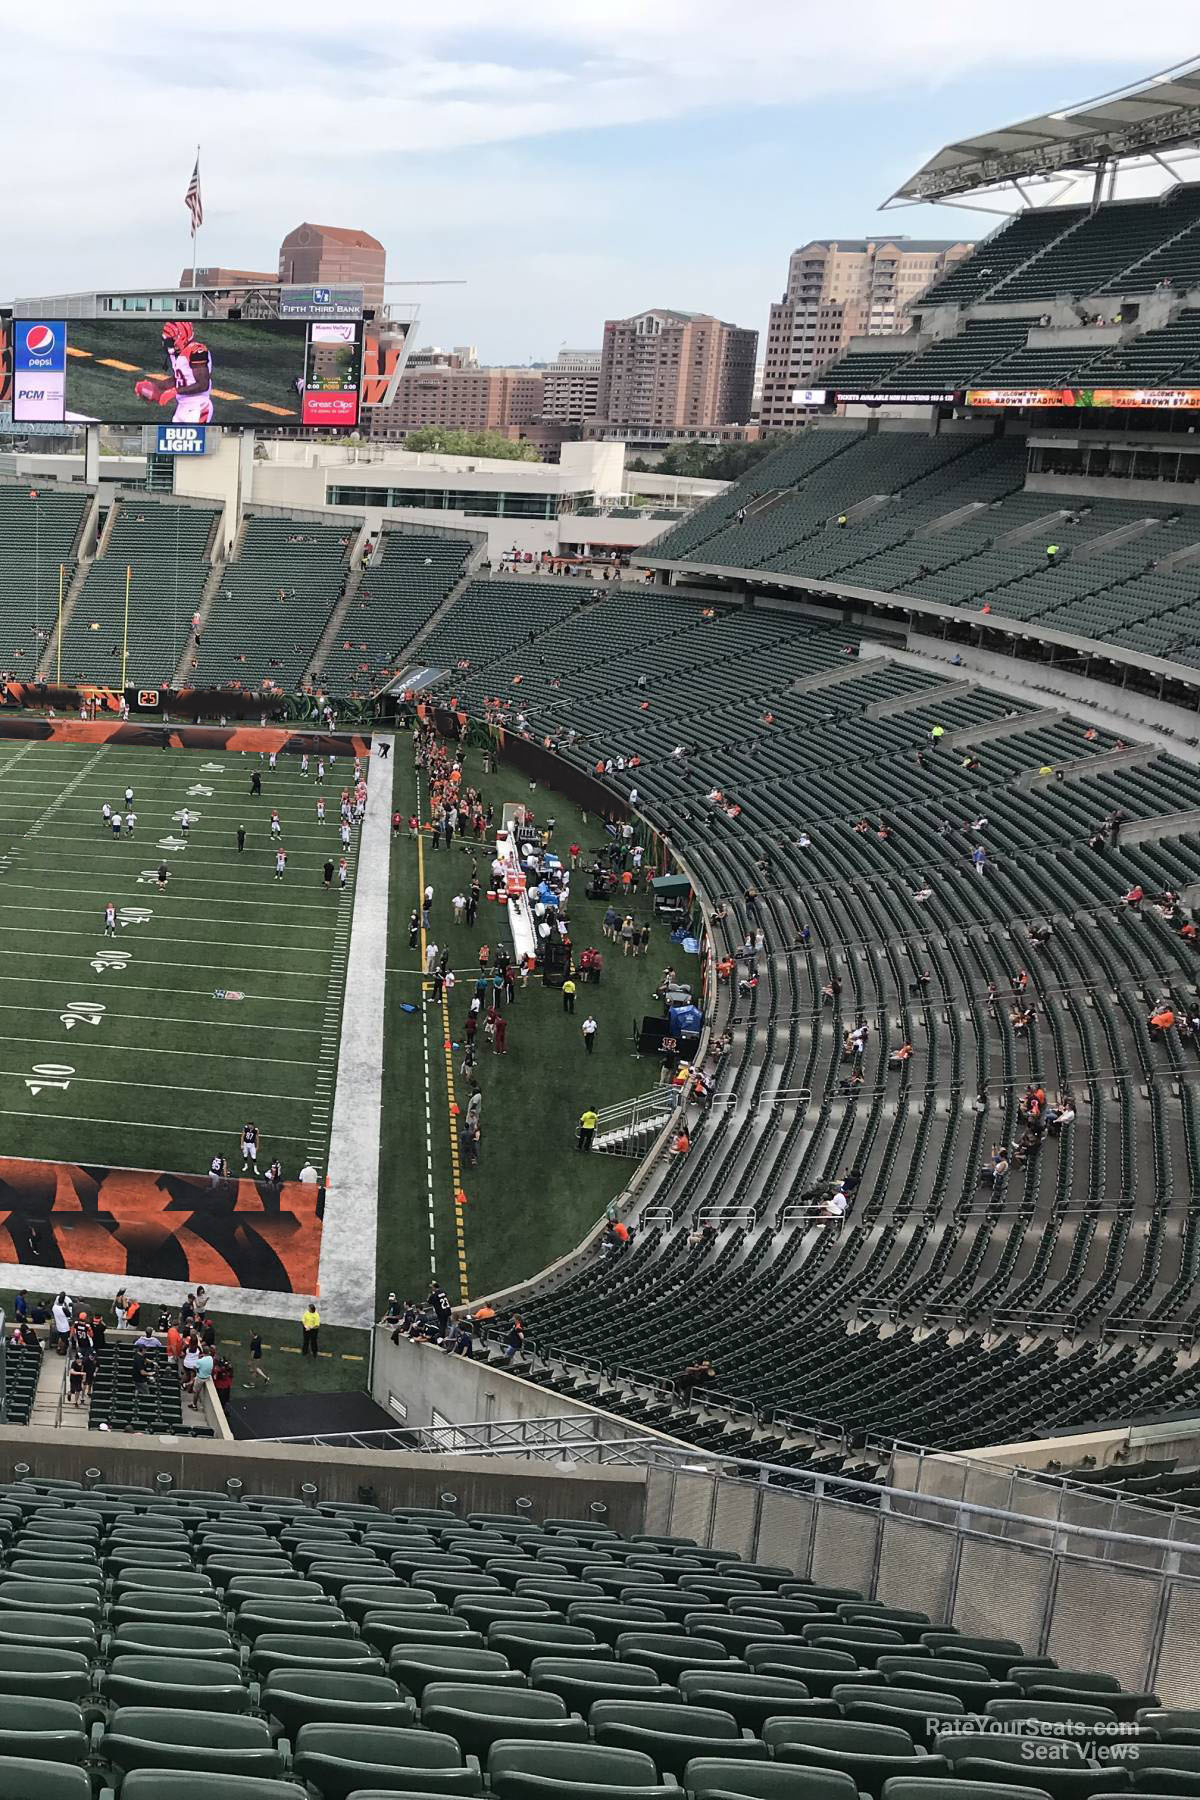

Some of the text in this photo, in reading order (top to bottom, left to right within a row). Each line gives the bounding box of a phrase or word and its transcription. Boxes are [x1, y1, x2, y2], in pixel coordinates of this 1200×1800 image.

[283, 305, 360, 313] FIFTH THIRD BANK
[28, 358, 52, 367] pepsi
[19, 390, 45, 400] PCM
[308, 400, 353, 409] Great Clips
[166, 428, 197, 440] BUD
[160, 440, 203, 451] LIGHT
[141, 692, 155, 704] 25
[116, 907, 153, 924] 40
[90, 950, 132, 970] 30
[60, 1002, 106, 1025] 20
[24, 1064, 75, 1090] 10
